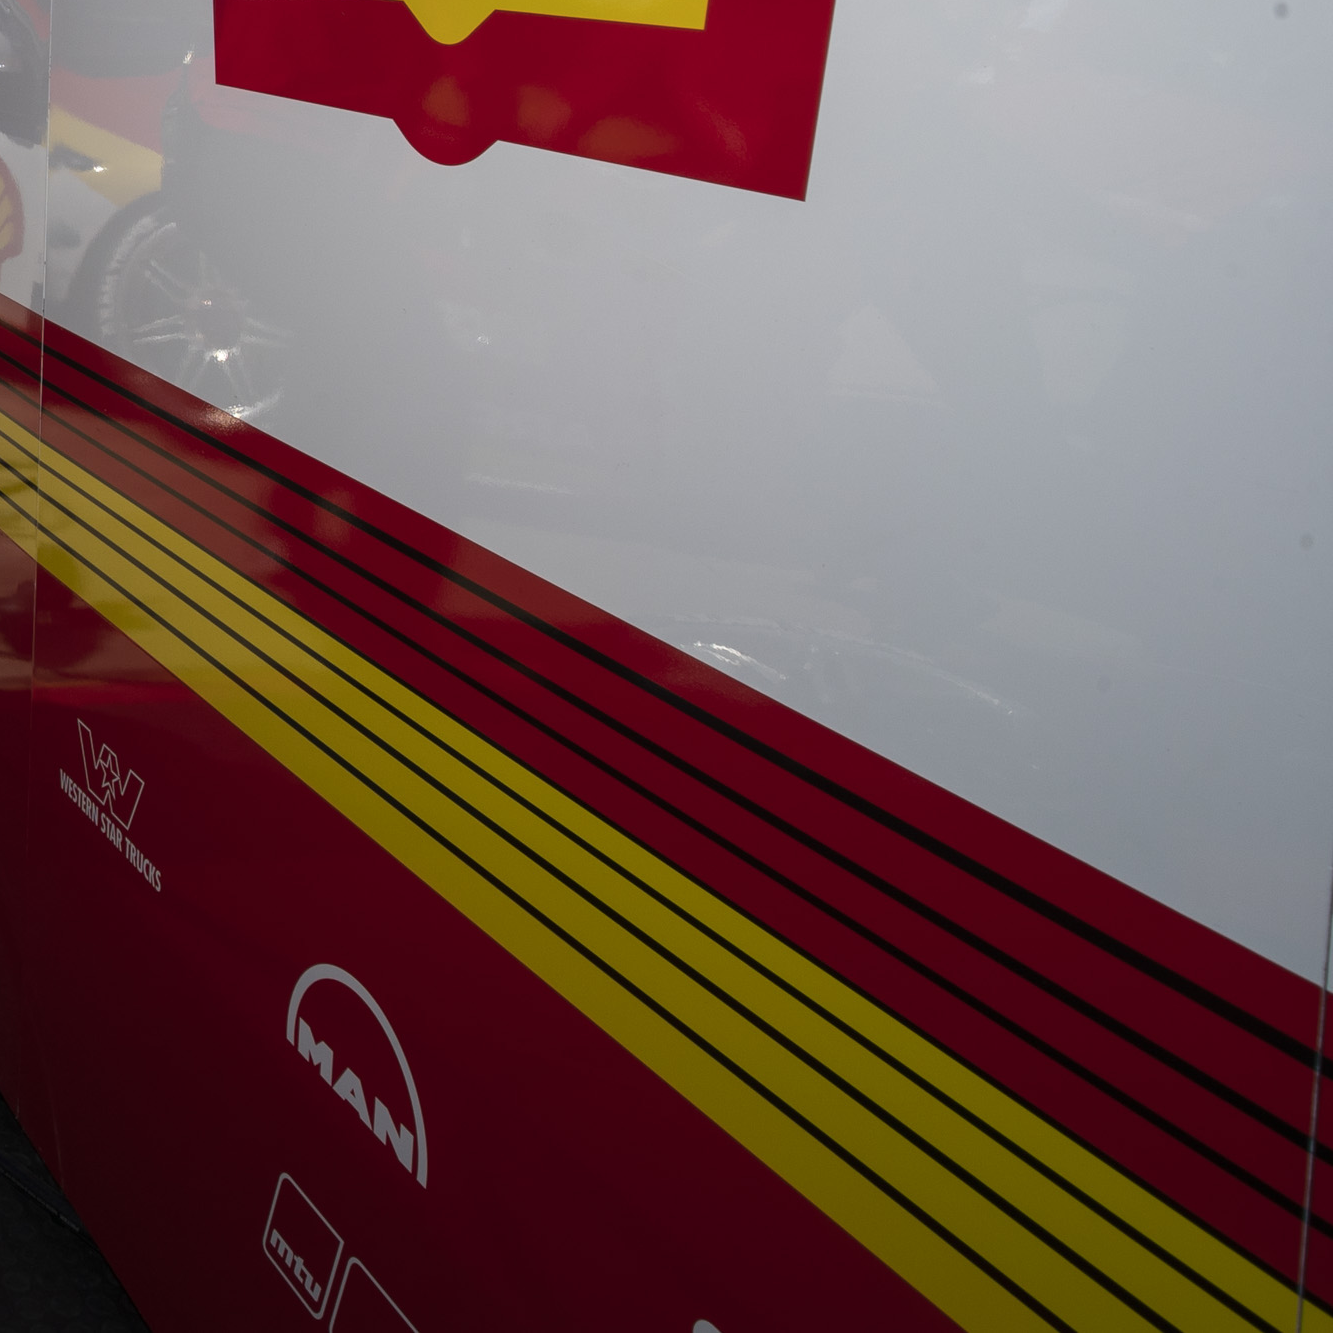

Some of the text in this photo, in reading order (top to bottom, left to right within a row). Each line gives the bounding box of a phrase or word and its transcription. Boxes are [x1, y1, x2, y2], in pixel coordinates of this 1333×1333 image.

[59, 768, 162, 893] WESTERN STAR TRUCKS
[297, 1016, 414, 1174] MAN
[269, 1228, 322, 1302] mtu
